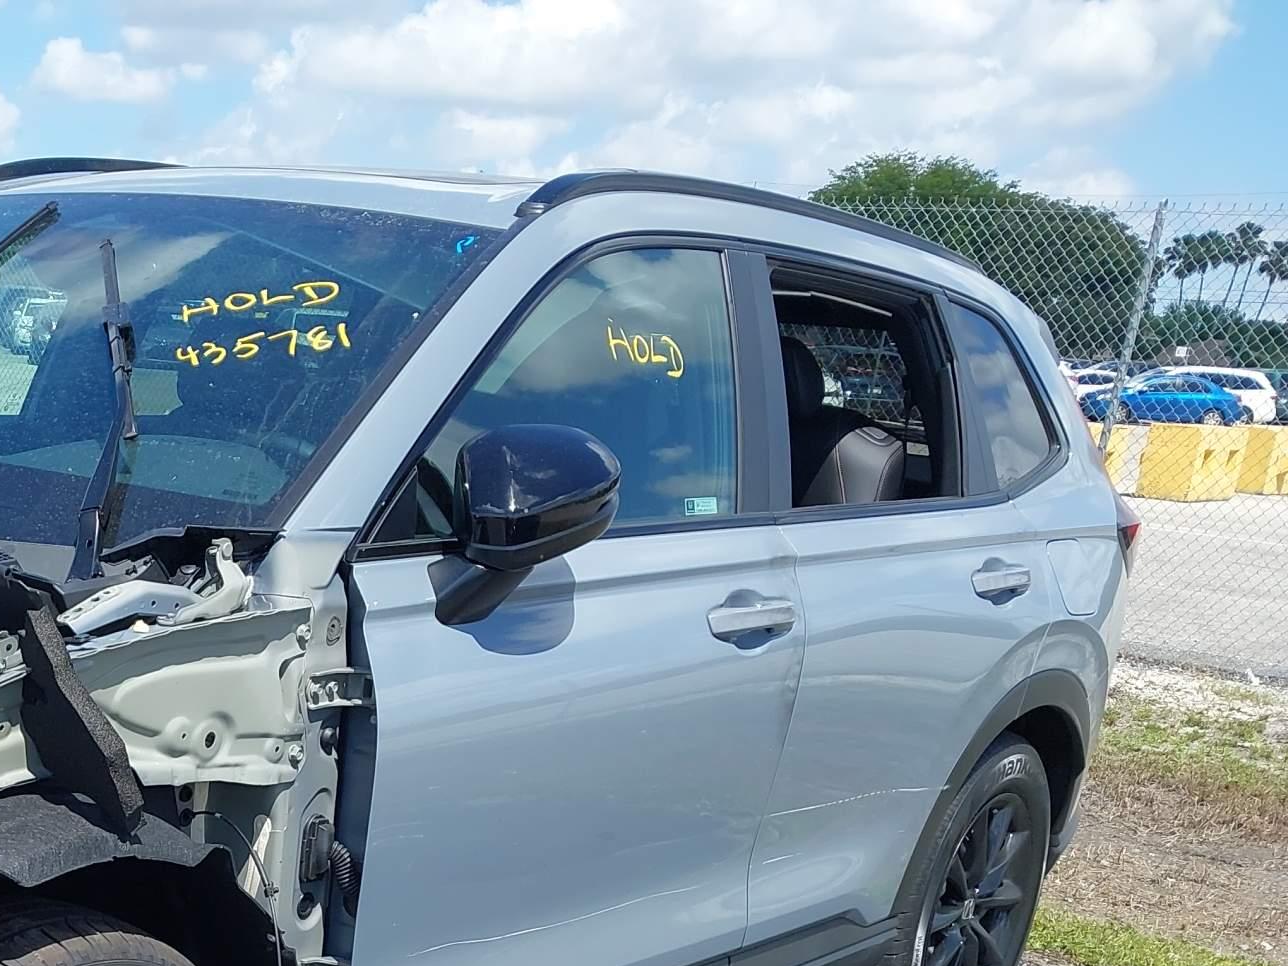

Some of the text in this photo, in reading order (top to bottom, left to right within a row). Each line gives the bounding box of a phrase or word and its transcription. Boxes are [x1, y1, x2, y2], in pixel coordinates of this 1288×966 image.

[182, 281, 340, 323] HOLD
[176, 323, 352, 367] 435781
[607, 318, 684, 378] HOLD
